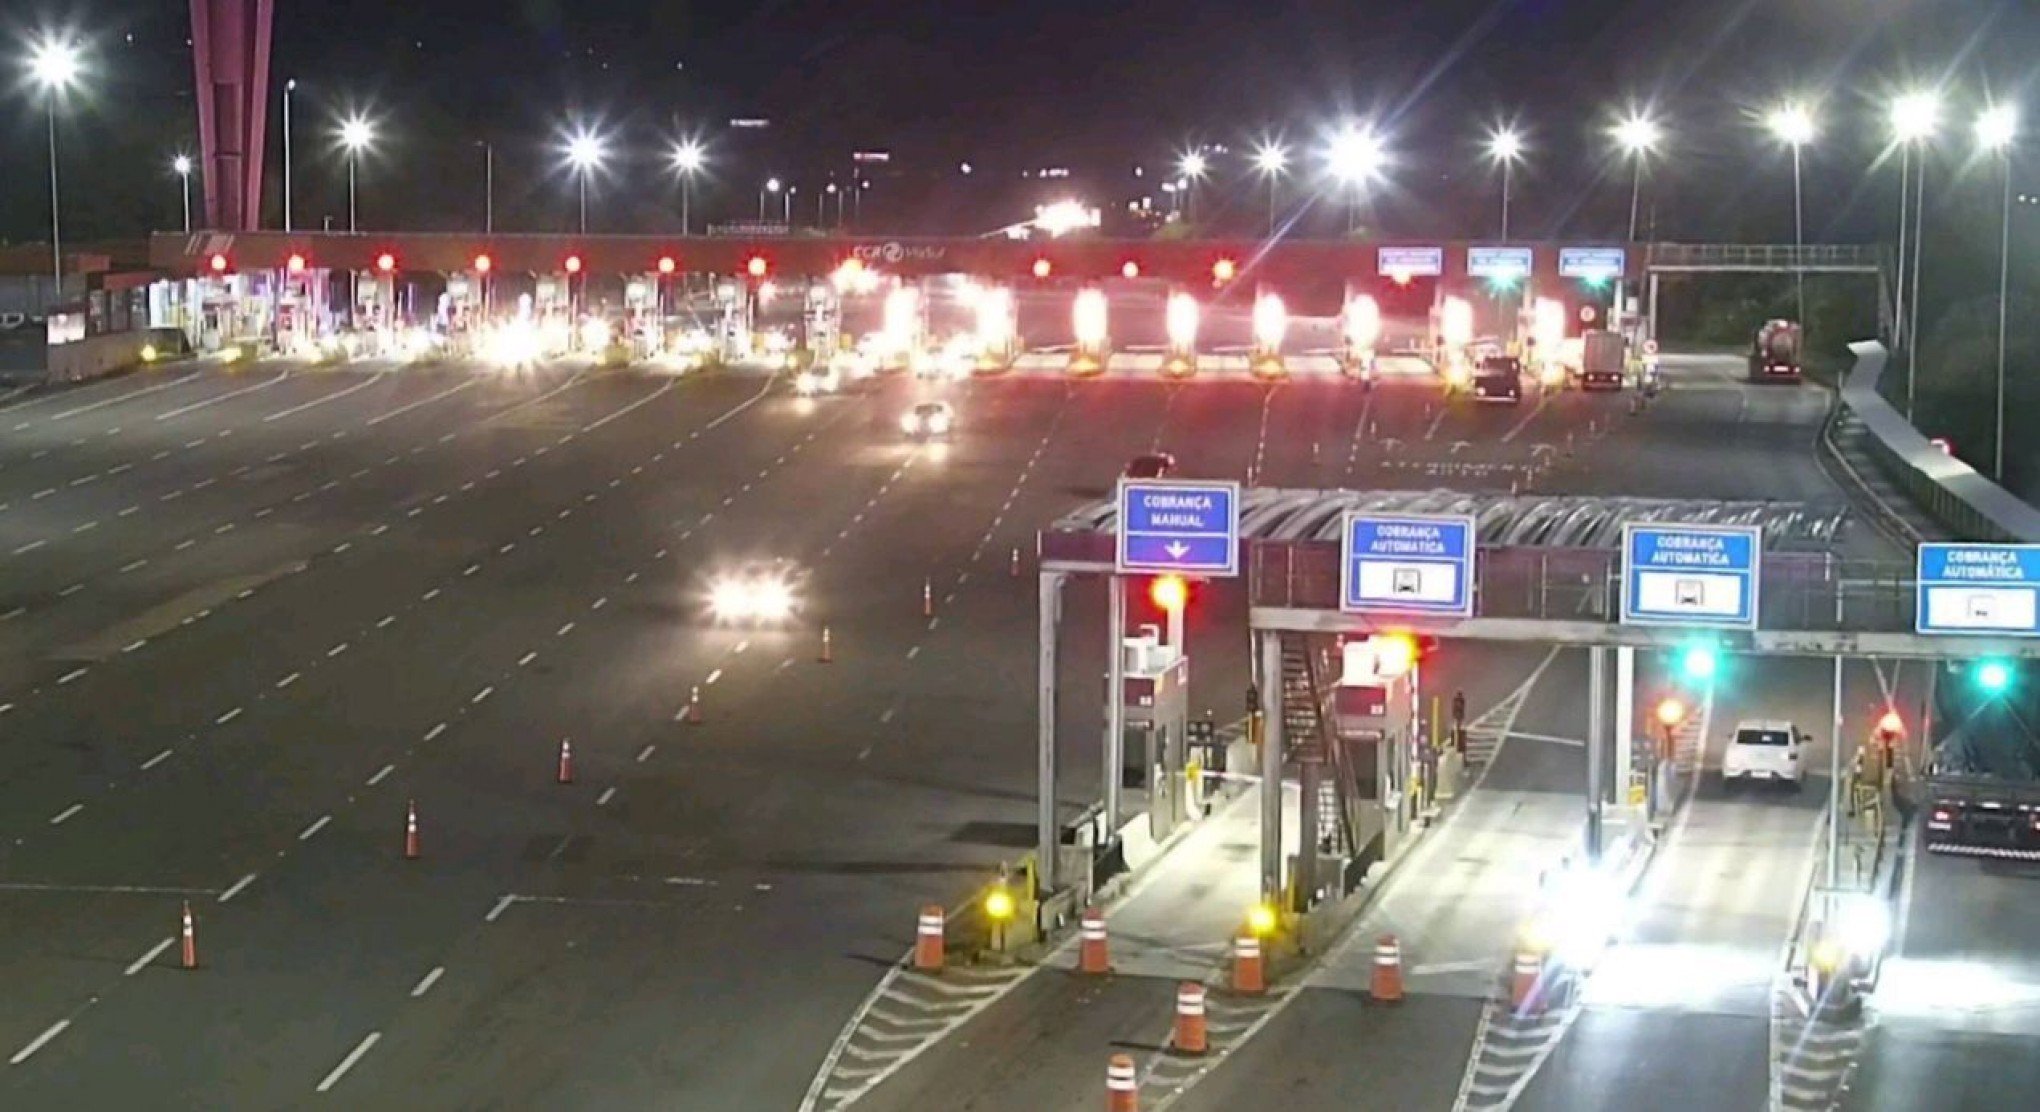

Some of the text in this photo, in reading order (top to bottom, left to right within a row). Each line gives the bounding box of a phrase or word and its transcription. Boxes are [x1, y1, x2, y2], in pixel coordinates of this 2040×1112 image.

[1143, 495, 1212, 510] COBRANÇA
[1151, 513, 1204, 527] MANUAL
[1377, 525, 1440, 540] COBRANÇA
[1656, 536, 1724, 551] COBRANÇA
[1946, 550, 2017, 565] COBRANÇA
